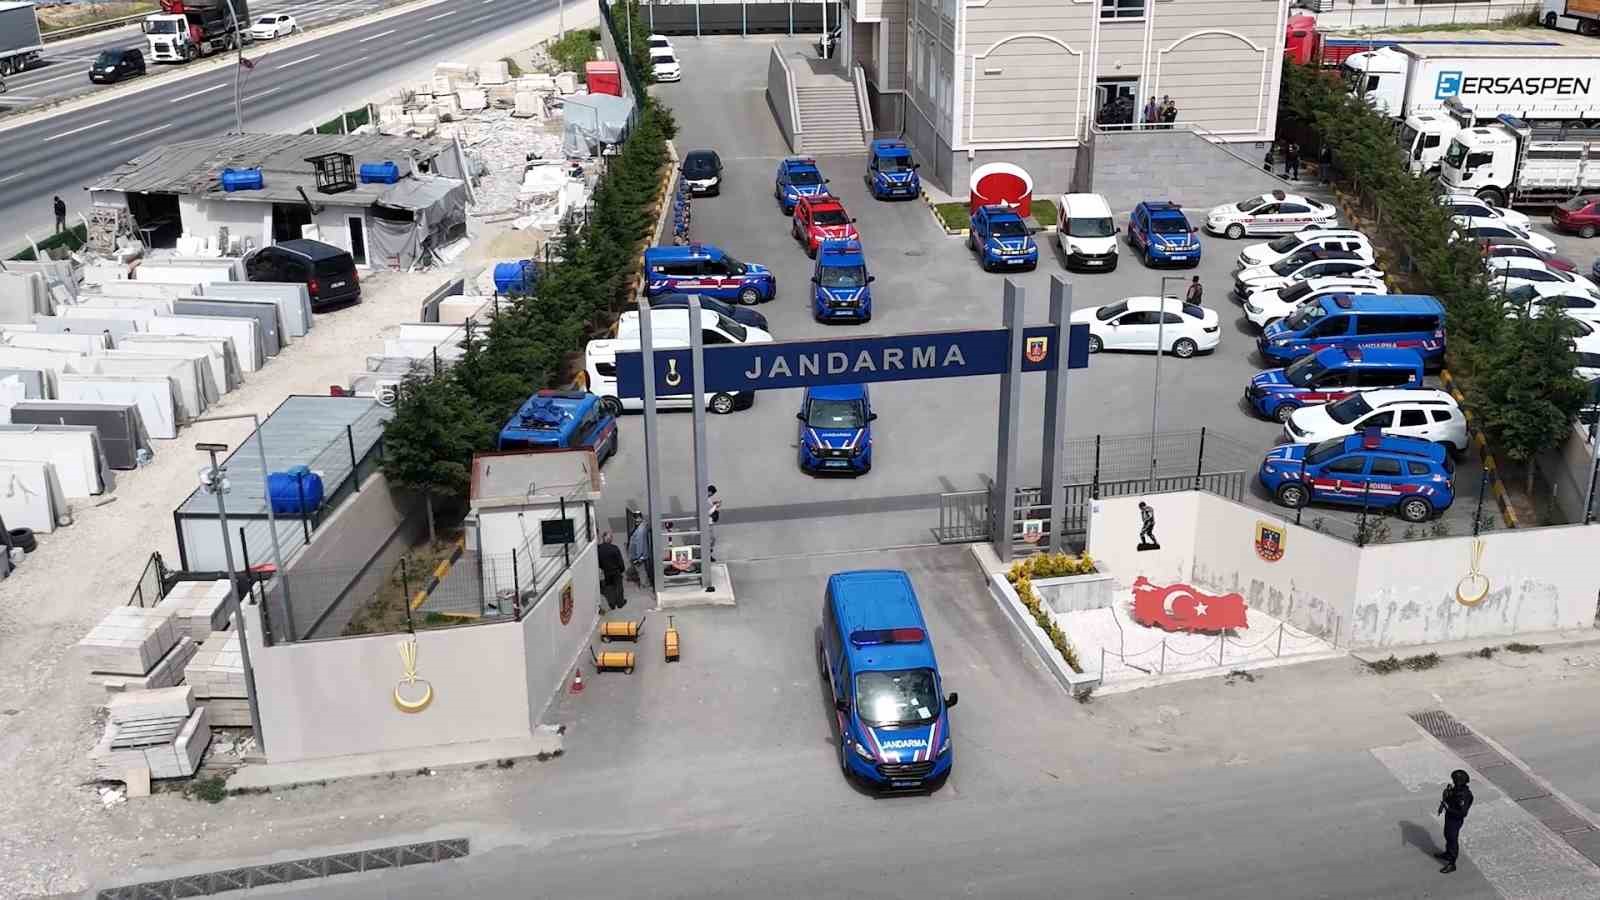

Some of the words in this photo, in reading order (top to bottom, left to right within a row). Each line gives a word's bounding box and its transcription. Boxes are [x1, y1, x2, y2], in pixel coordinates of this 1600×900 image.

[1461, 77, 1592, 95] ERSAŞPEN
[745, 344, 966, 379] JANDARMA
[881, 739, 928, 749] JANDARMA
